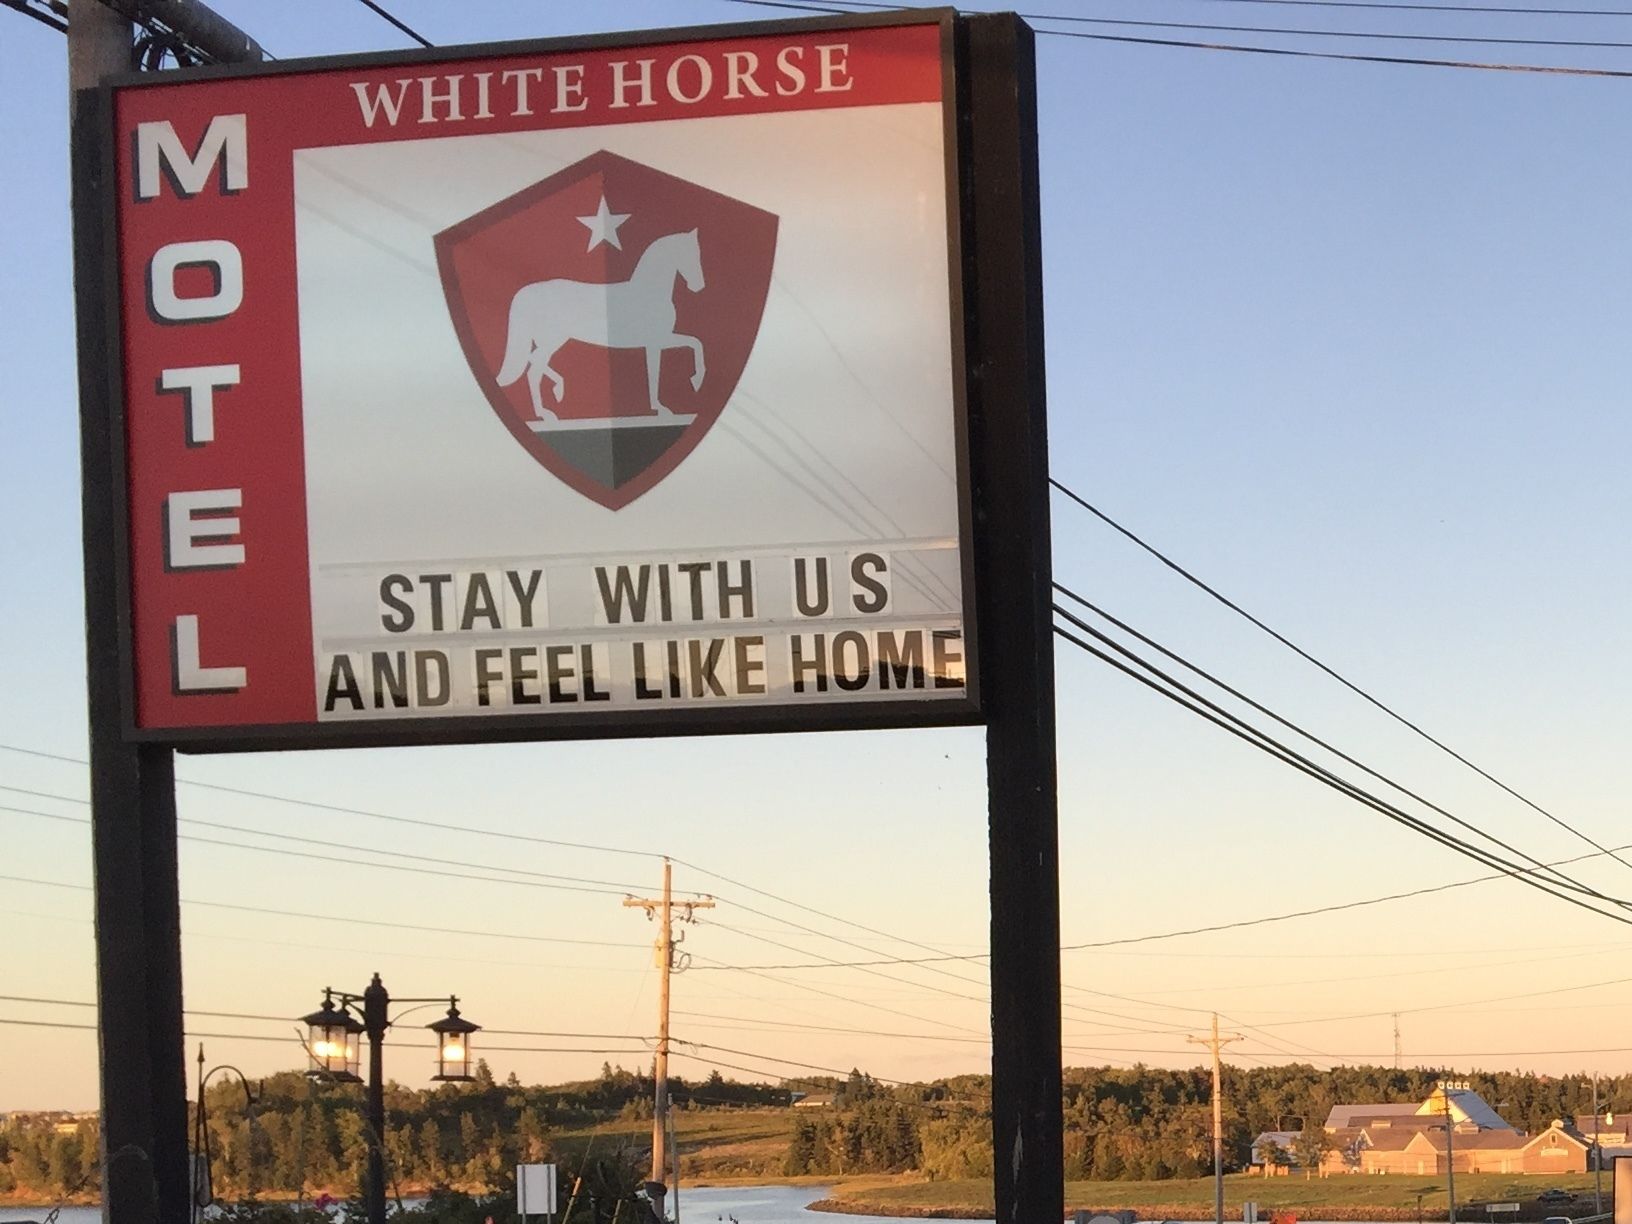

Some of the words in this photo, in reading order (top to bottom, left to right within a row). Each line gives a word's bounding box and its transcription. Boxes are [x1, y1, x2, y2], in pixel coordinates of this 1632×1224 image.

[350, 65, 589, 127] WHITE
[608, 43, 854, 108] HORSE
[134, 114, 248, 692] MOTEL
[380, 569, 542, 633] STAY
[595, 560, 754, 623] WITH
[795, 553, 888, 616] US
[324, 650, 450, 711] AND
[476, 644, 611, 706] FEEL
[632, 636, 765, 699] LIKE
[791, 630, 965, 693] HOME
